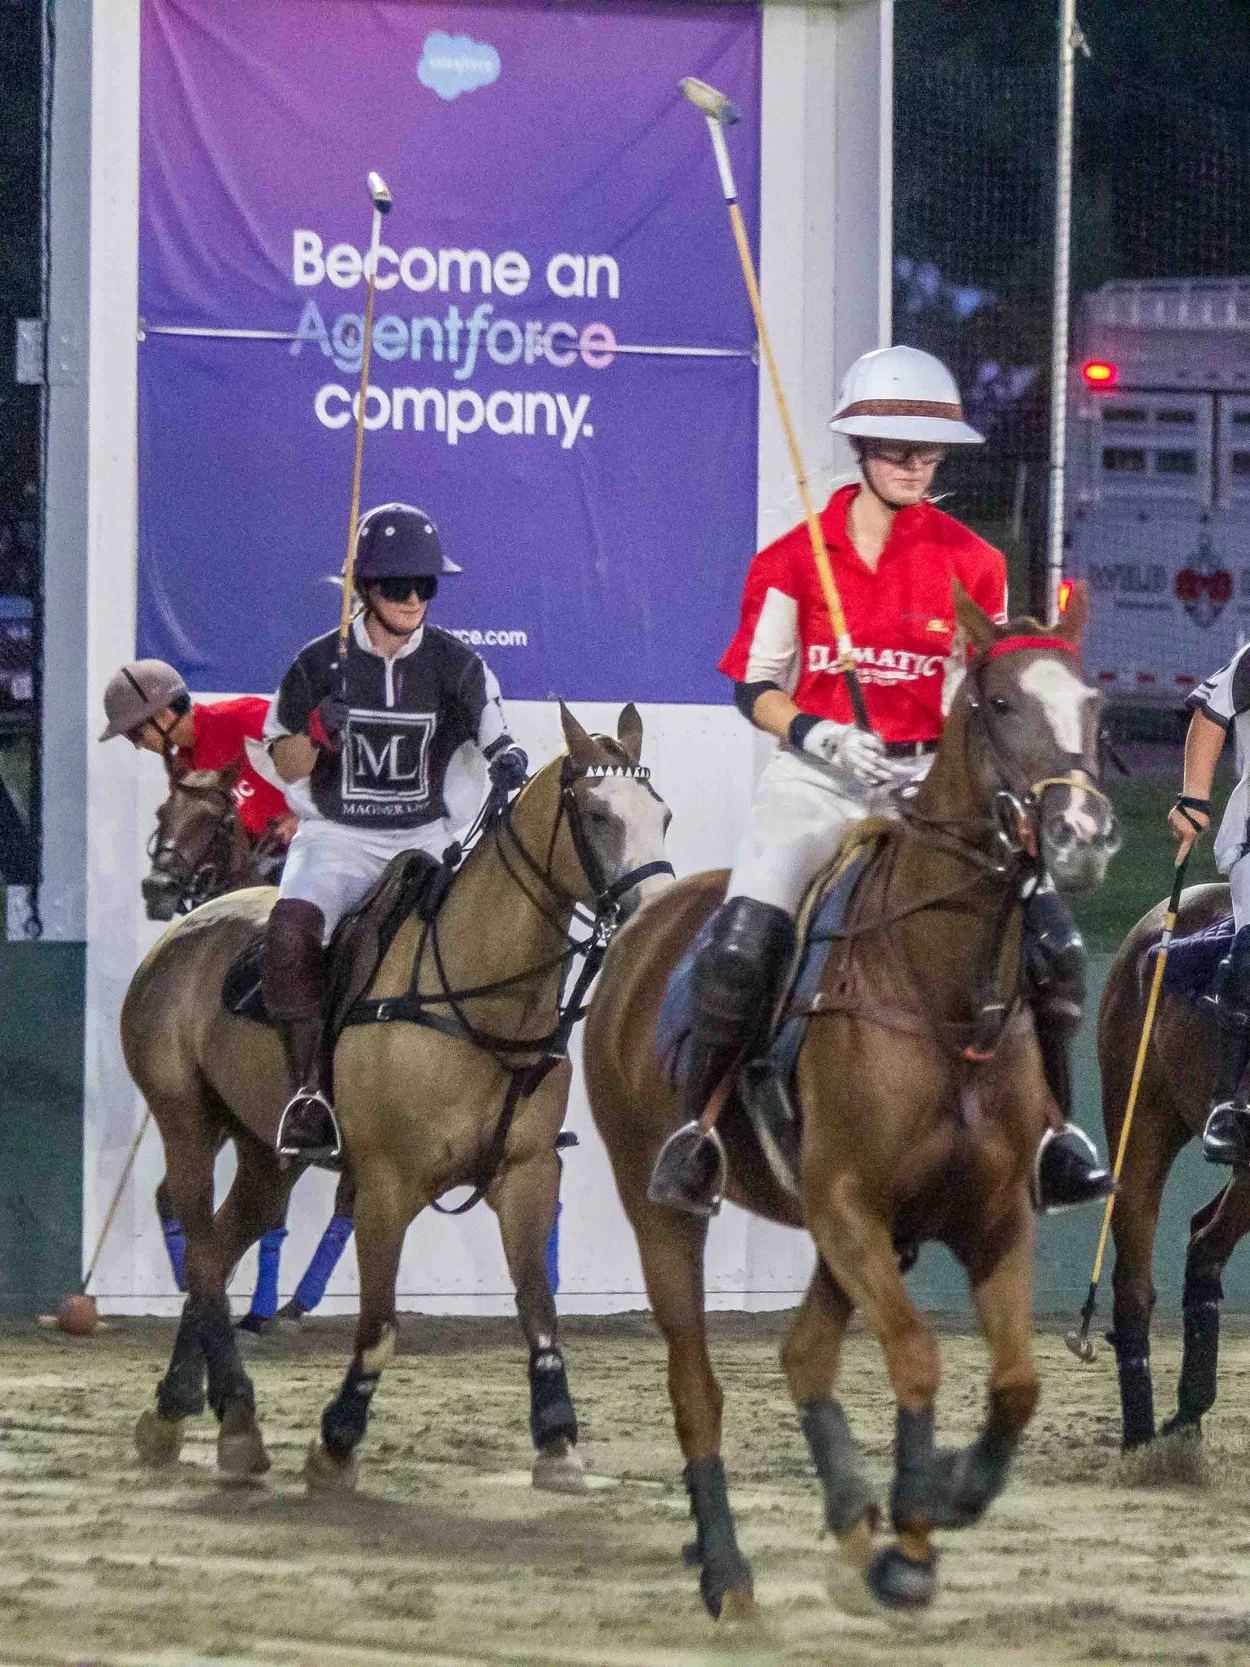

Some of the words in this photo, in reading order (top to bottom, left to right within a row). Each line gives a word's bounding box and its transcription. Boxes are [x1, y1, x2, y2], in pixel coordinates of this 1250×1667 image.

[293, 229, 530, 296] Become
[546, 253, 620, 299] an
[288, 299, 617, 381] Agentforce
[313, 383, 594, 449] company.
[351, 731, 419, 780] ML
